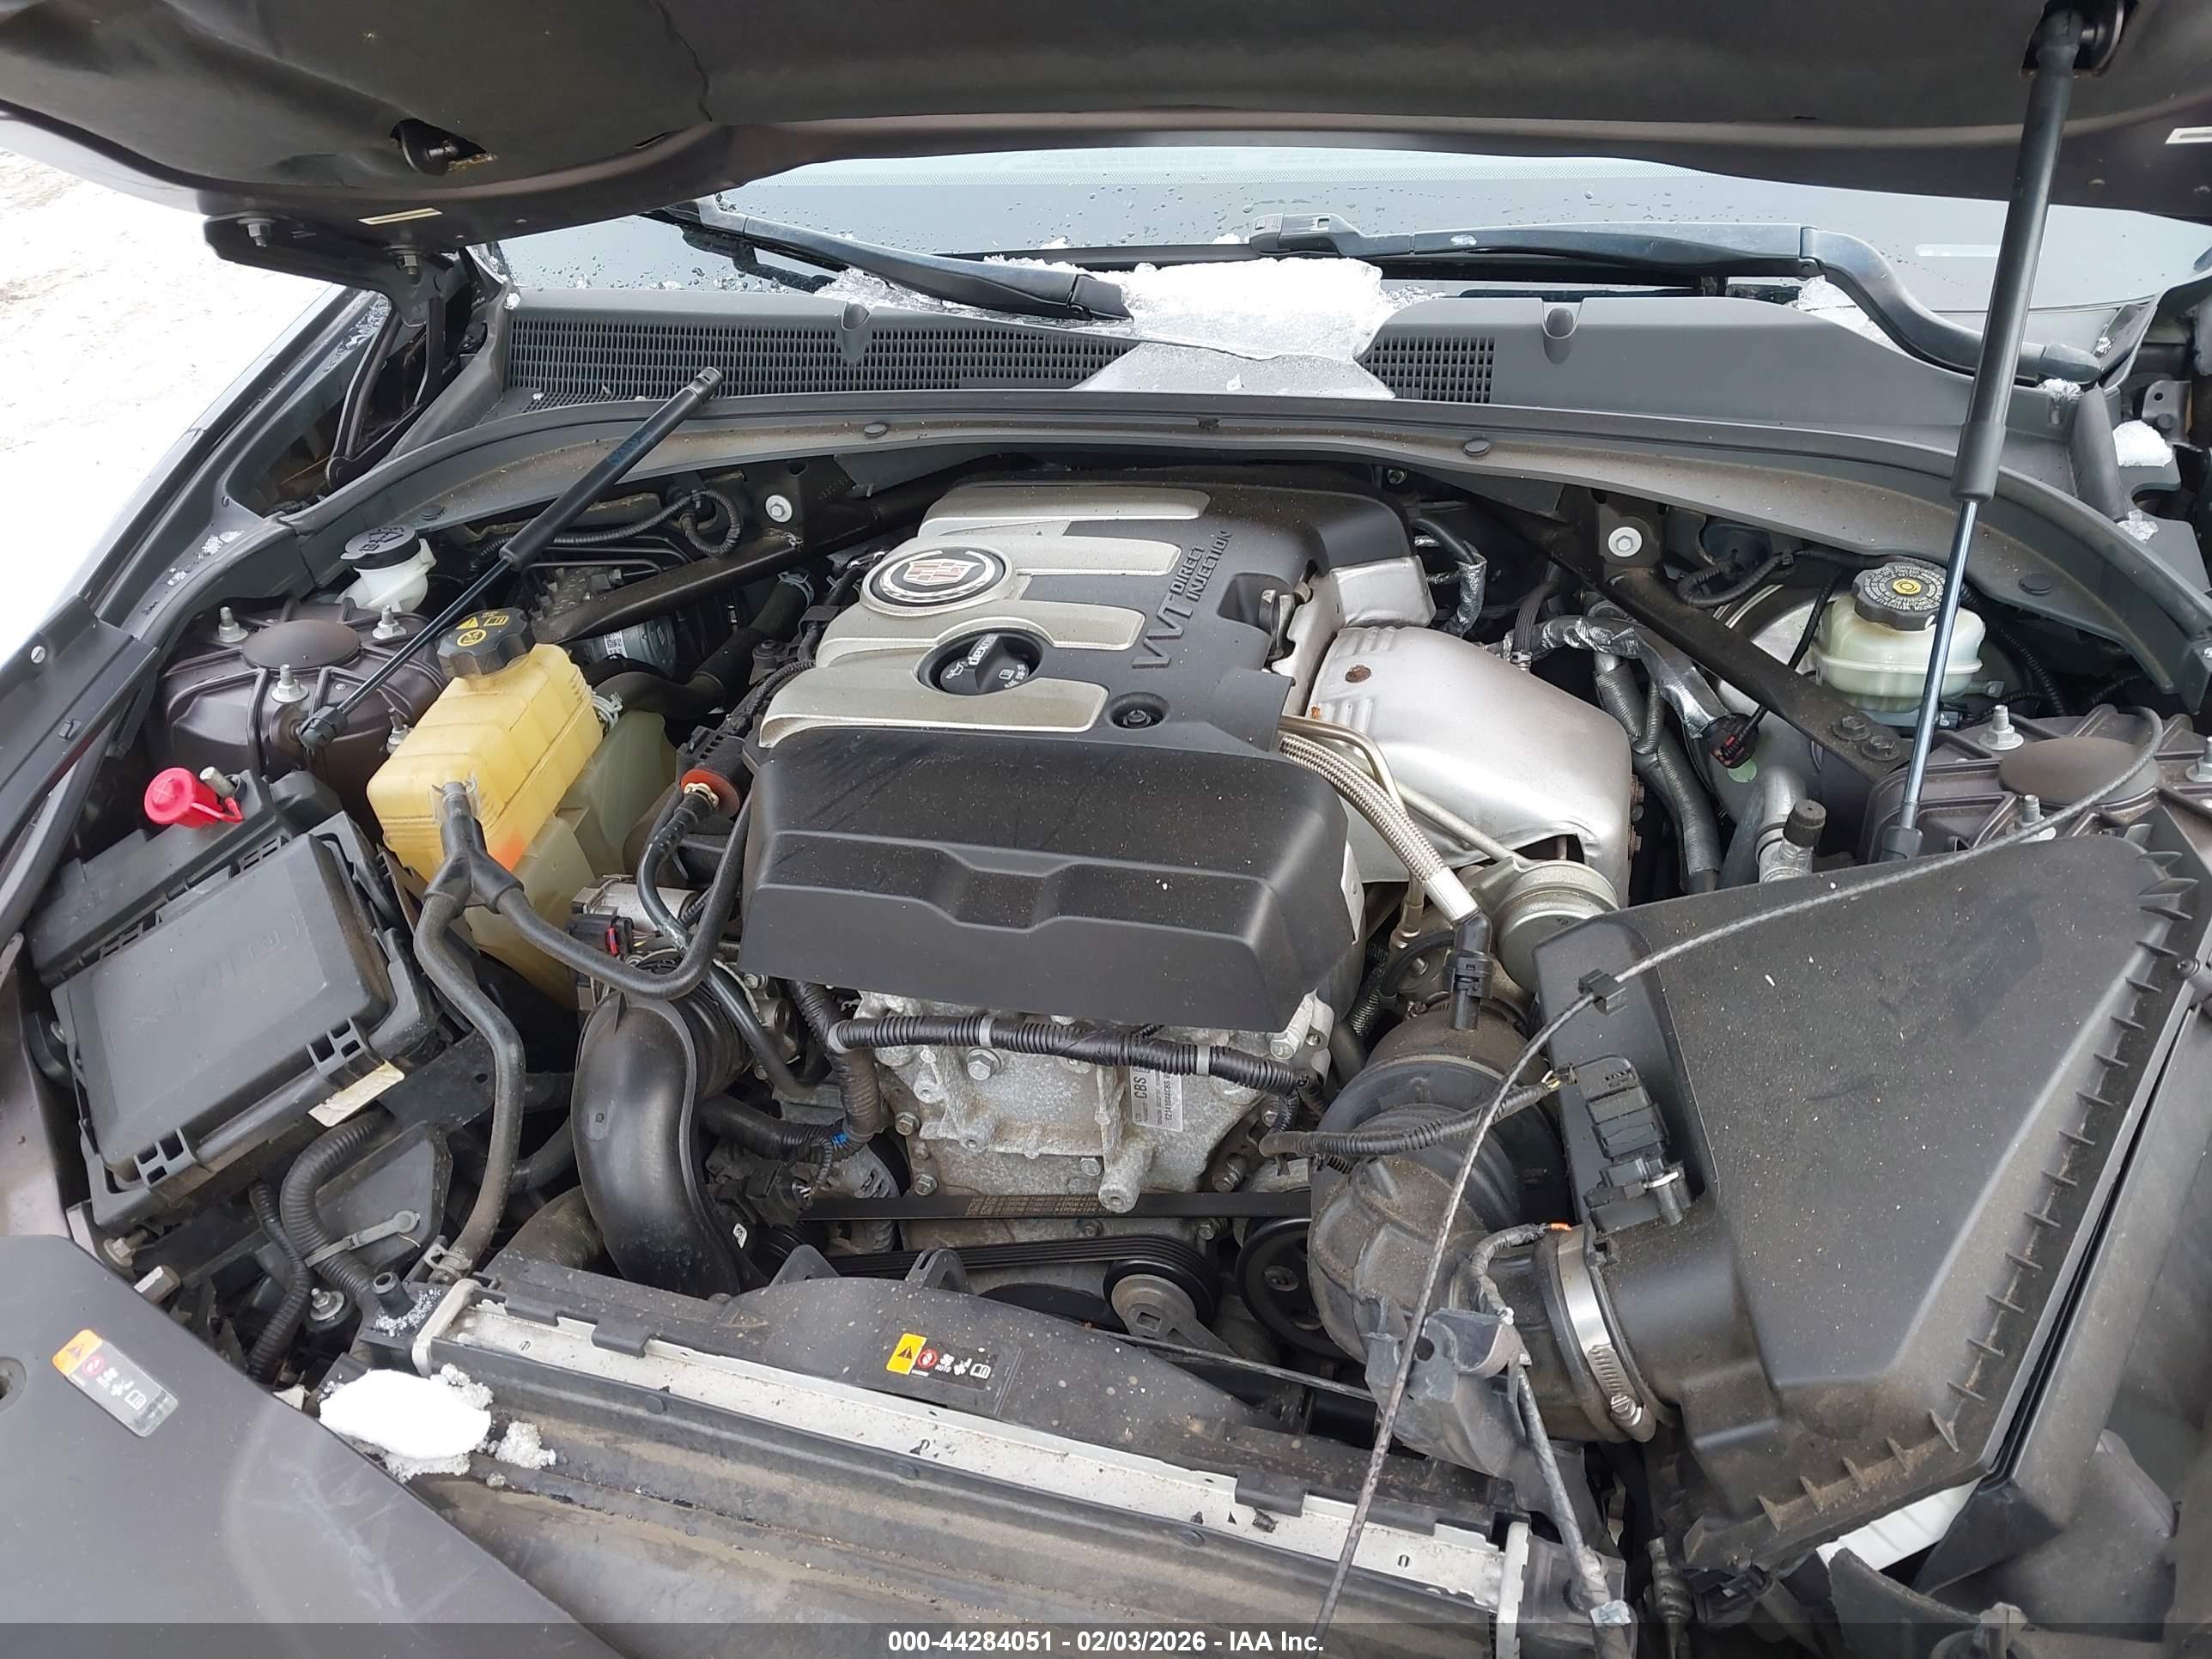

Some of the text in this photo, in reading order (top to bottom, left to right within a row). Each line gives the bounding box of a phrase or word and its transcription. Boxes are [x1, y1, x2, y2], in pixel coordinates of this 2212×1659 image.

[1170, 546, 1205, 595] DIRECT
[1186, 530, 1233, 602] INJECTION
[1132, 592, 1193, 669] VVT
[1133, 1076, 1148, 1099] CBS
